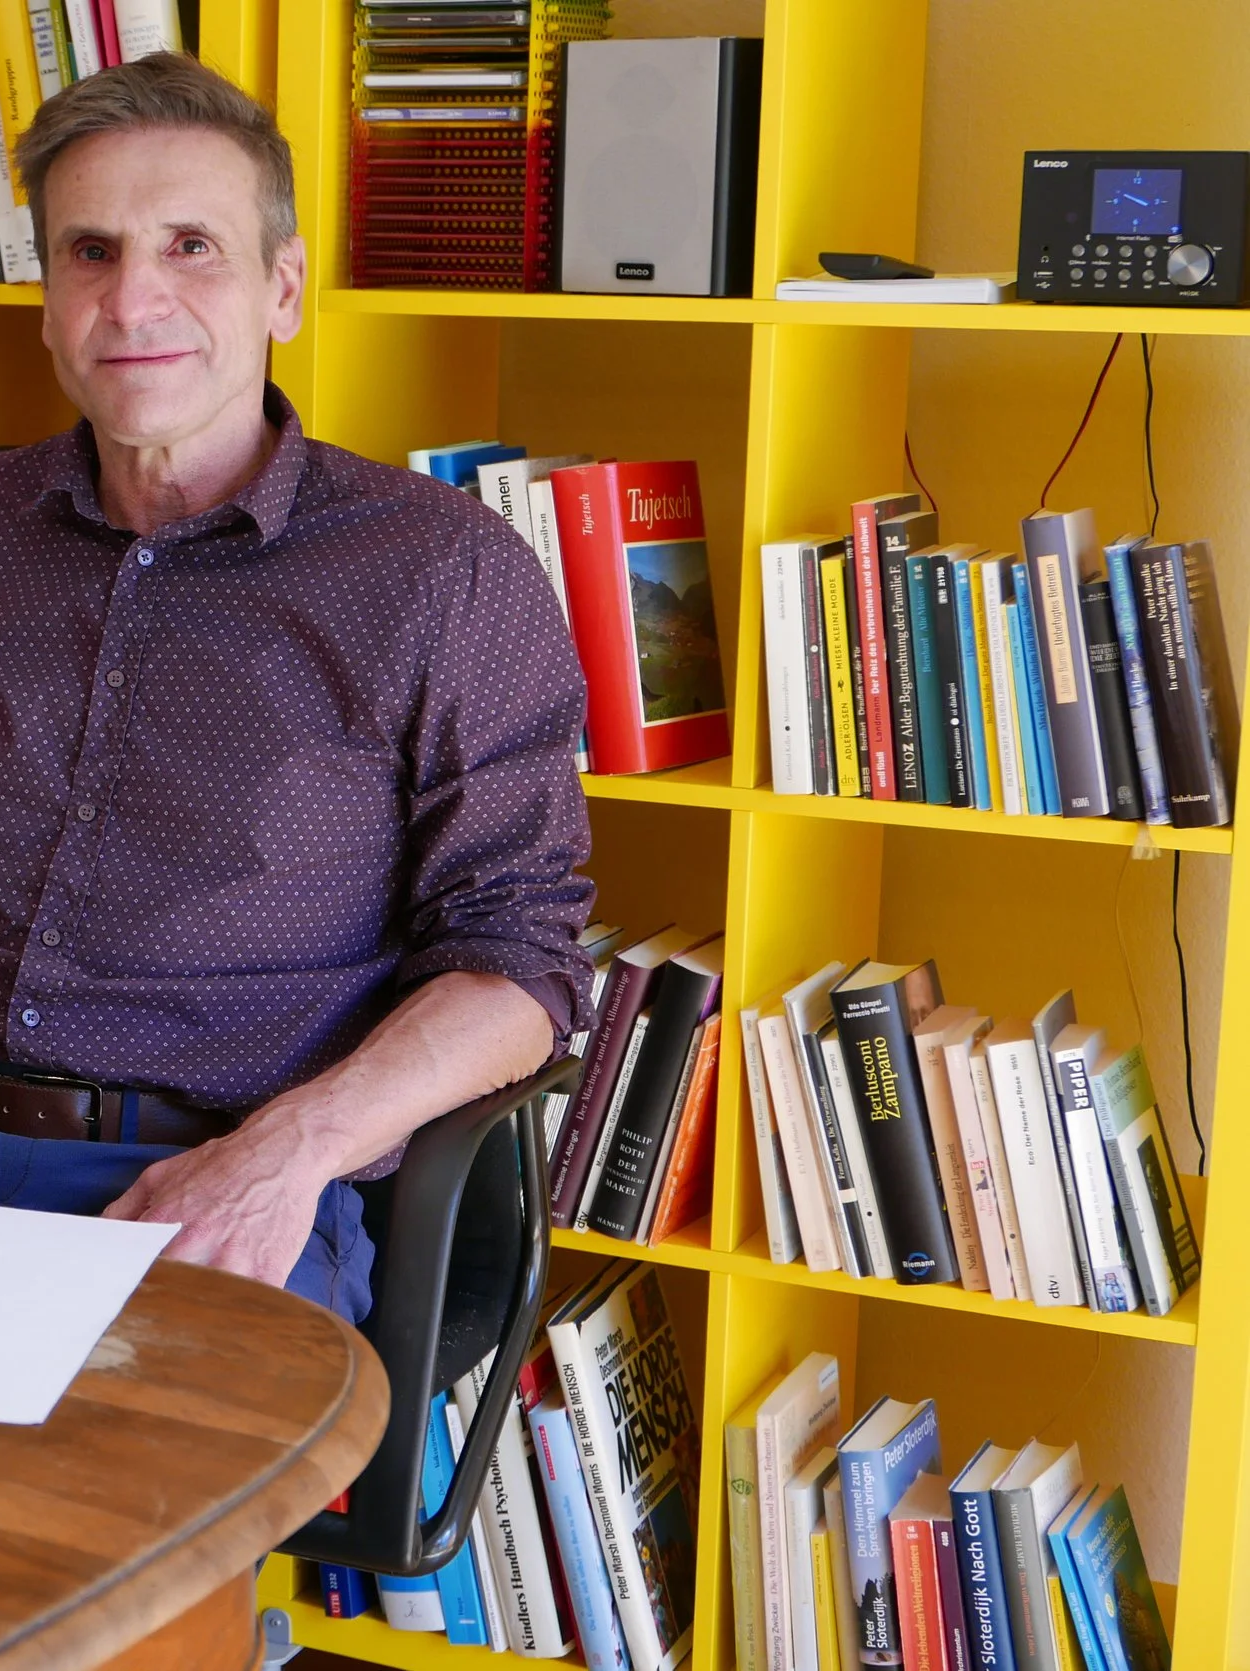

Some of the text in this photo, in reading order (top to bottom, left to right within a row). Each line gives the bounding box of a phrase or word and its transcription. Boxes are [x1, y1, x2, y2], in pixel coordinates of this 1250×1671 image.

[1034, 159, 1068, 169] Lenco
[619, 266, 649, 277] Lenco
[498, 476, 513, 527] manen
[579, 494, 594, 536] Tujetsch
[627, 485, 692, 530] Tujetsch
[540, 513, 549, 553] sursilvan
[829, 578, 837, 608] MORDE
[1114, 557, 1126, 592] BOSCH
[1141, 564, 1157, 618] Peter Handke
[831, 611, 840, 641] KLEINE
[859, 517, 883, 742] Landmann Der Reiz des Verbrechens und der Halbwelt
[916, 586, 931, 672] Bernhard Meister
[1046, 564, 1072, 696] Julian Unbefugtes Betreten
[1153, 562, 1178, 690] In einer dunklen Nacht ging ich
[1164, 560, 1186, 658] aus meinem stillen Haus
[834, 644, 843, 669] MIESE
[1130, 663, 1142, 687] Hacke
[892, 576, 917, 788] LENOZ der Familie
[842, 702, 853, 760] ADLER-OLSEN
[856, 686, 867, 750] Borchert Draußen
[949, 683, 966, 795] Luciano dialogoi
[878, 771, 886, 787] orell
[1171, 794, 1211, 803] Suhrkamp
[843, 1006, 890, 1019] Ferruccio Pinotti
[848, 1002, 860, 1010] Udo
[626, 1034, 642, 1065] Gingganz
[551, 971, 629, 1201] Madeleine Albright Der Mächtige und der Allmächtige
[856, 1040, 885, 1121] Berlusconi
[874, 1037, 901, 1119] Zampano
[1014, 1076, 1023, 1095] Rose
[1067, 1062, 1091, 1108] PIPER
[1018, 1097, 1027, 1108] der
[1020, 1110, 1030, 1132] Name
[620, 1144, 645, 1159] ROTH
[622, 1128, 653, 1145] PHILIP
[818, 1086, 846, 1179] Franz Kafka Die Verwandlung
[1024, 1133, 1032, 1147] Der
[606, 1179, 637, 1196] MAKEL
[618, 1159, 637, 1172] DER
[1103, 1125, 1134, 1212] Thomas Bernhard Die
[575, 1212, 590, 1229] dtv
[597, 1216, 625, 1232] HANSER
[946, 1144, 978, 1270] Nadolny Die Entdeckung der Langsamkeit
[902, 1257, 935, 1270] Riemann
[1047, 1280, 1060, 1299] dtv
[595, 1327, 623, 1363] Peter Marsh
[599, 1347, 623, 1381] Desmond
[605, 1326, 680, 1429] DIE HORDE
[617, 1370, 694, 1496] MENSCH
[884, 1410, 936, 1473] Peter Sloterdijk
[563, 1363, 630, 1599] Peter Marsh Desmond Morris DIE HORDE MENSCH
[763, 1428, 780, 1633] Zwickel Die Welt des Alten und Neuen Testaments
[851, 1462, 867, 1557] Den Himmel zum
[861, 1462, 880, 1557] Sprechen bringen
[500, 1519, 524, 1590] Handbuch
[909, 1545, 927, 1655] lebenden Weltreligionen
[963, 1499, 996, 1664] Sloterdijk Nach Gott
[1010, 1503, 1036, 1656] MICHAEL HAMPE Das Leben
[1070, 1592, 1079, 1606] Gott
[331, 1595, 340, 1613] UTB
[513, 1593, 536, 1650] Kindlers
[873, 1597, 888, 1648] Sloterdijk
[865, 1620, 876, 1647] Peter
